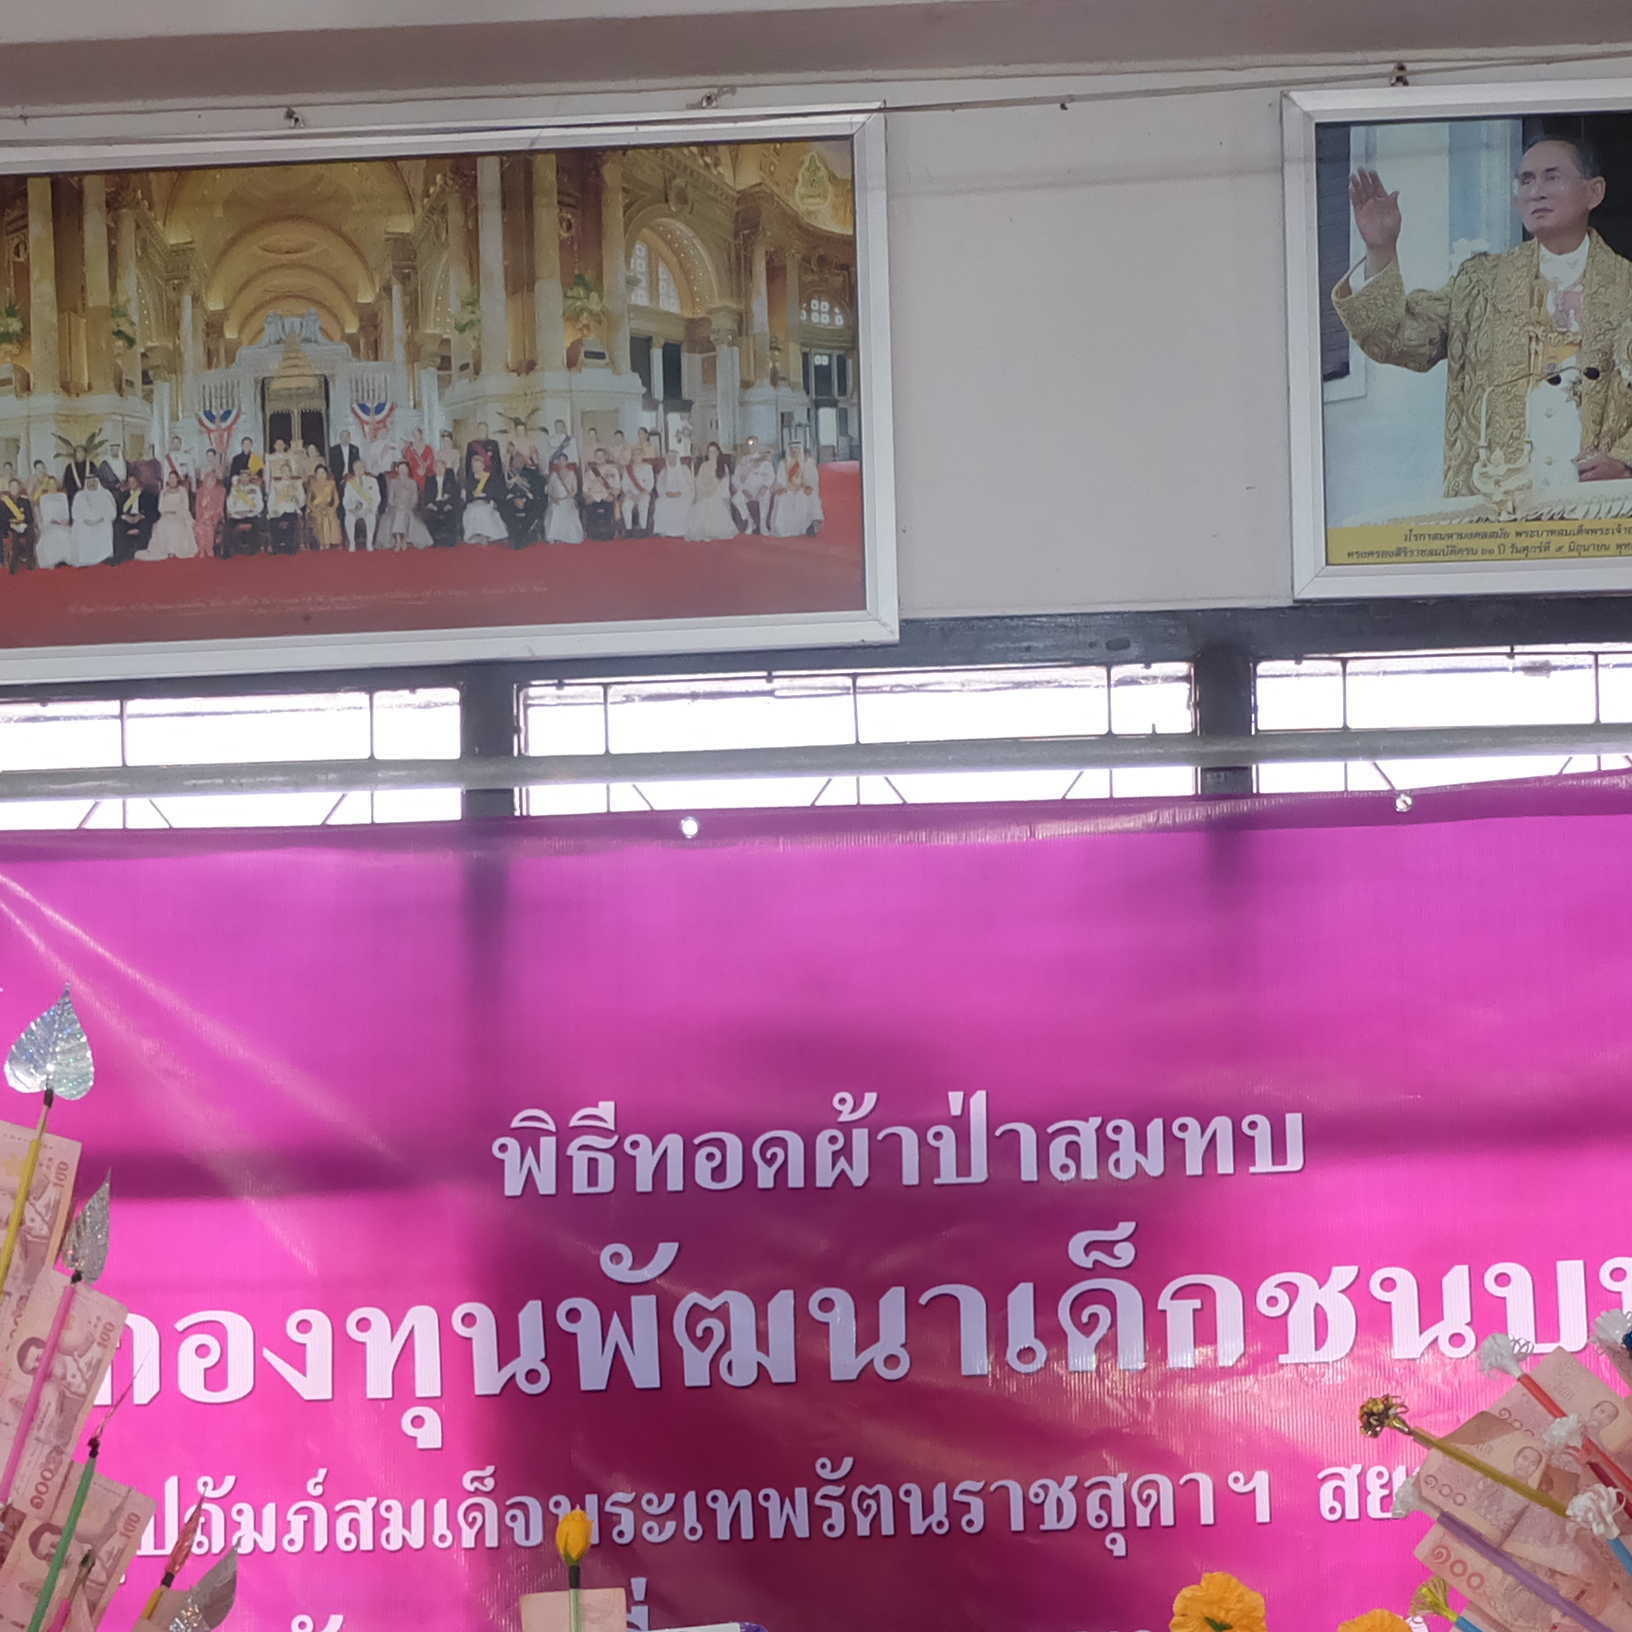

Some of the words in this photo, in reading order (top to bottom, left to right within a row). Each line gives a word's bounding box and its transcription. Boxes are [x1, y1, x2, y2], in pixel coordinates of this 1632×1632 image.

[491, 1088, 1307, 1200] พิธีทอดผ้าป่าสมทบ
[132, 1464, 1272, 1572] ปถัมภ์สมเด็จพระเทพรัตนราชสุดาฯ
[1430, 1544, 1486, 1592] ๑๐๐
